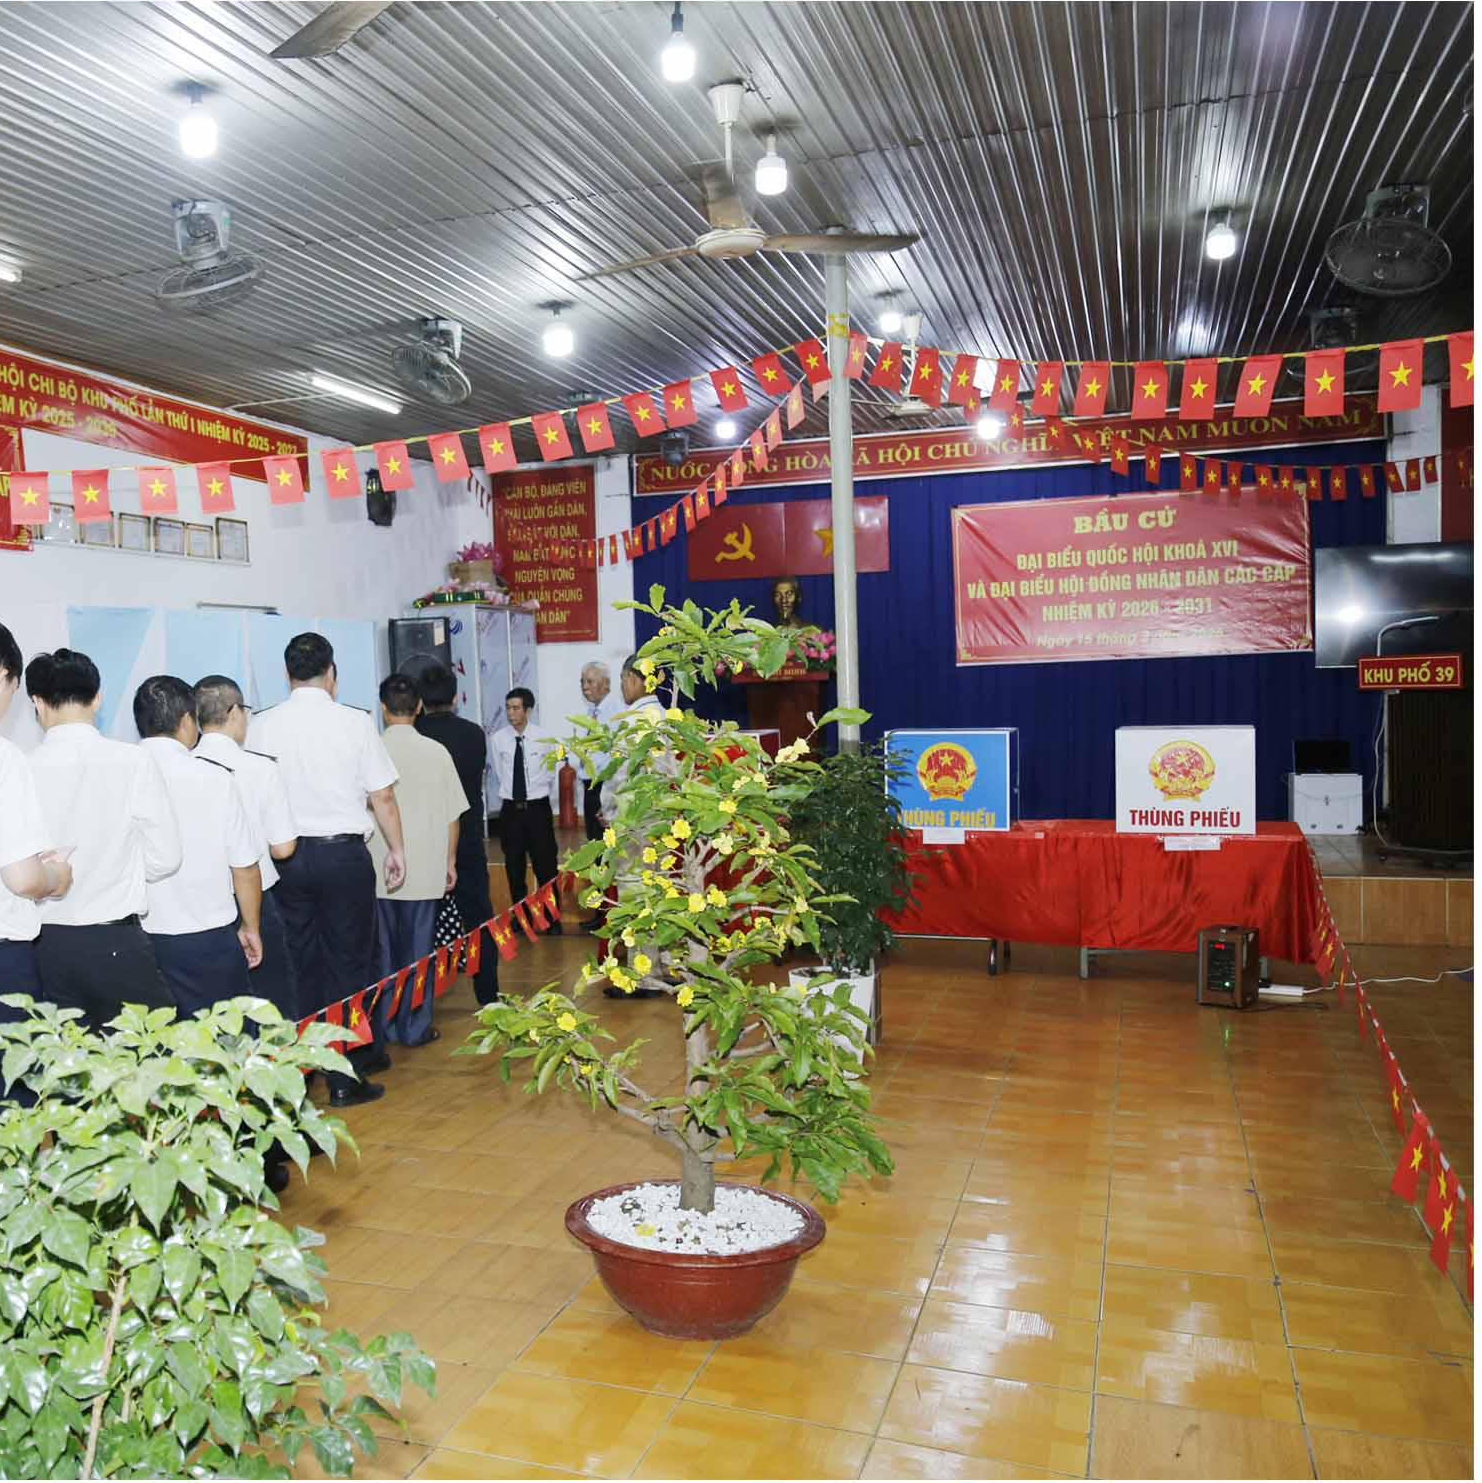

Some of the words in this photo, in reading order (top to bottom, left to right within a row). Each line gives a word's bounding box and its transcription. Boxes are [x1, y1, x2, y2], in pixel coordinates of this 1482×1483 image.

[196, 419, 232, 445] NHIỆM
[247, 433, 270, 453] 2025
[877, 443, 921, 467] HỘI
[1073, 506, 1128, 535] BẦU
[1137, 507, 1178, 530] CỬ
[1016, 551, 1042, 572] ĐẠI
[1046, 544, 1081, 569] BIỂU
[1086, 544, 1128, 568] QUỐC
[1133, 541, 1159, 565] HỘI
[1163, 538, 1206, 561] KHOÁ
[1211, 539, 1239, 559] XVI
[1041, 599, 1093, 624] NHIỆM
[1096, 595, 1116, 620] KỲ
[1120, 596, 1159, 617] 2026
[1363, 667, 1394, 685] KHU
[1398, 660, 1431, 684] PHỐ
[1435, 666, 1455, 683] 39
[950, 807, 996, 828] PHIẾU
[1129, 806, 1184, 827] THÙNG
[1189, 805, 1241, 828] PHIẾU
